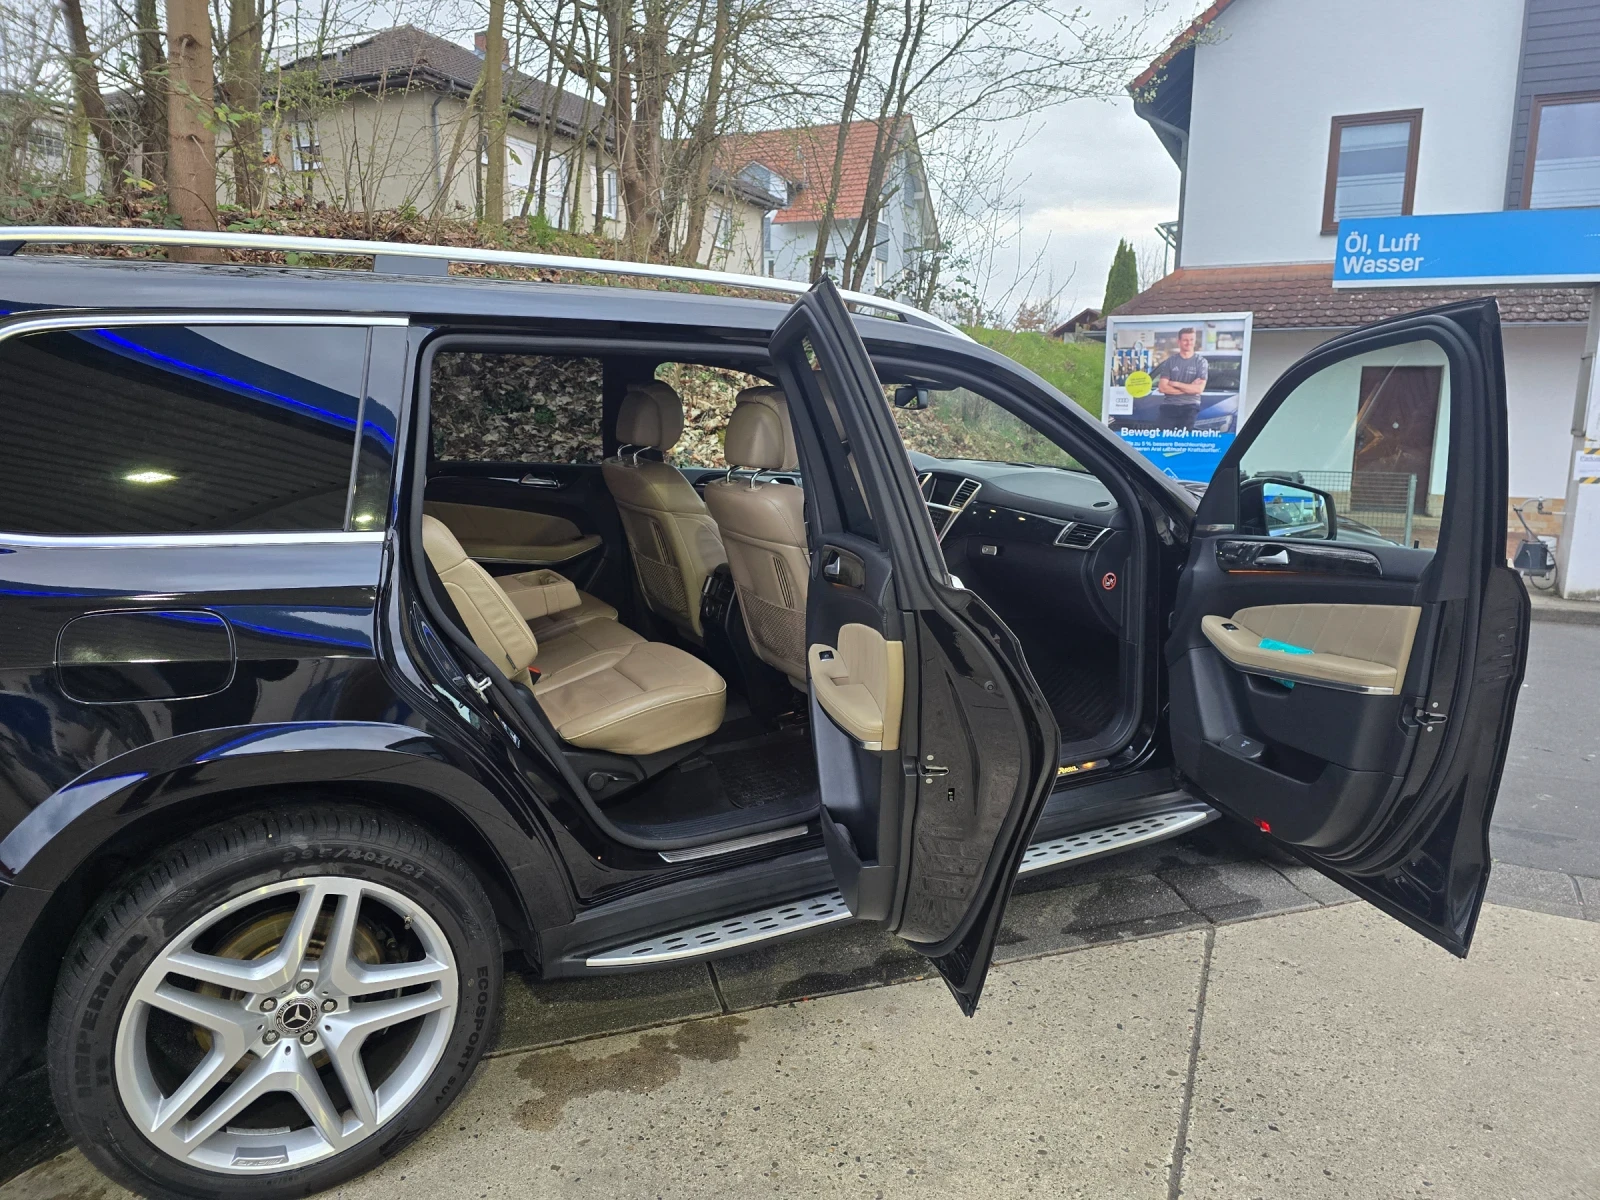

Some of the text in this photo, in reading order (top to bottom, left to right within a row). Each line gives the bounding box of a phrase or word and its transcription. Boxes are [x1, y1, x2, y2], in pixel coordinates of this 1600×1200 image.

[1344, 231, 1421, 256] Öl, Luft
[1342, 255, 1425, 275] Wasser
[1120, 426, 1222, 439] Bewegt mich mehr.
[435, 965, 489, 1105] ECOSPORT SUV
